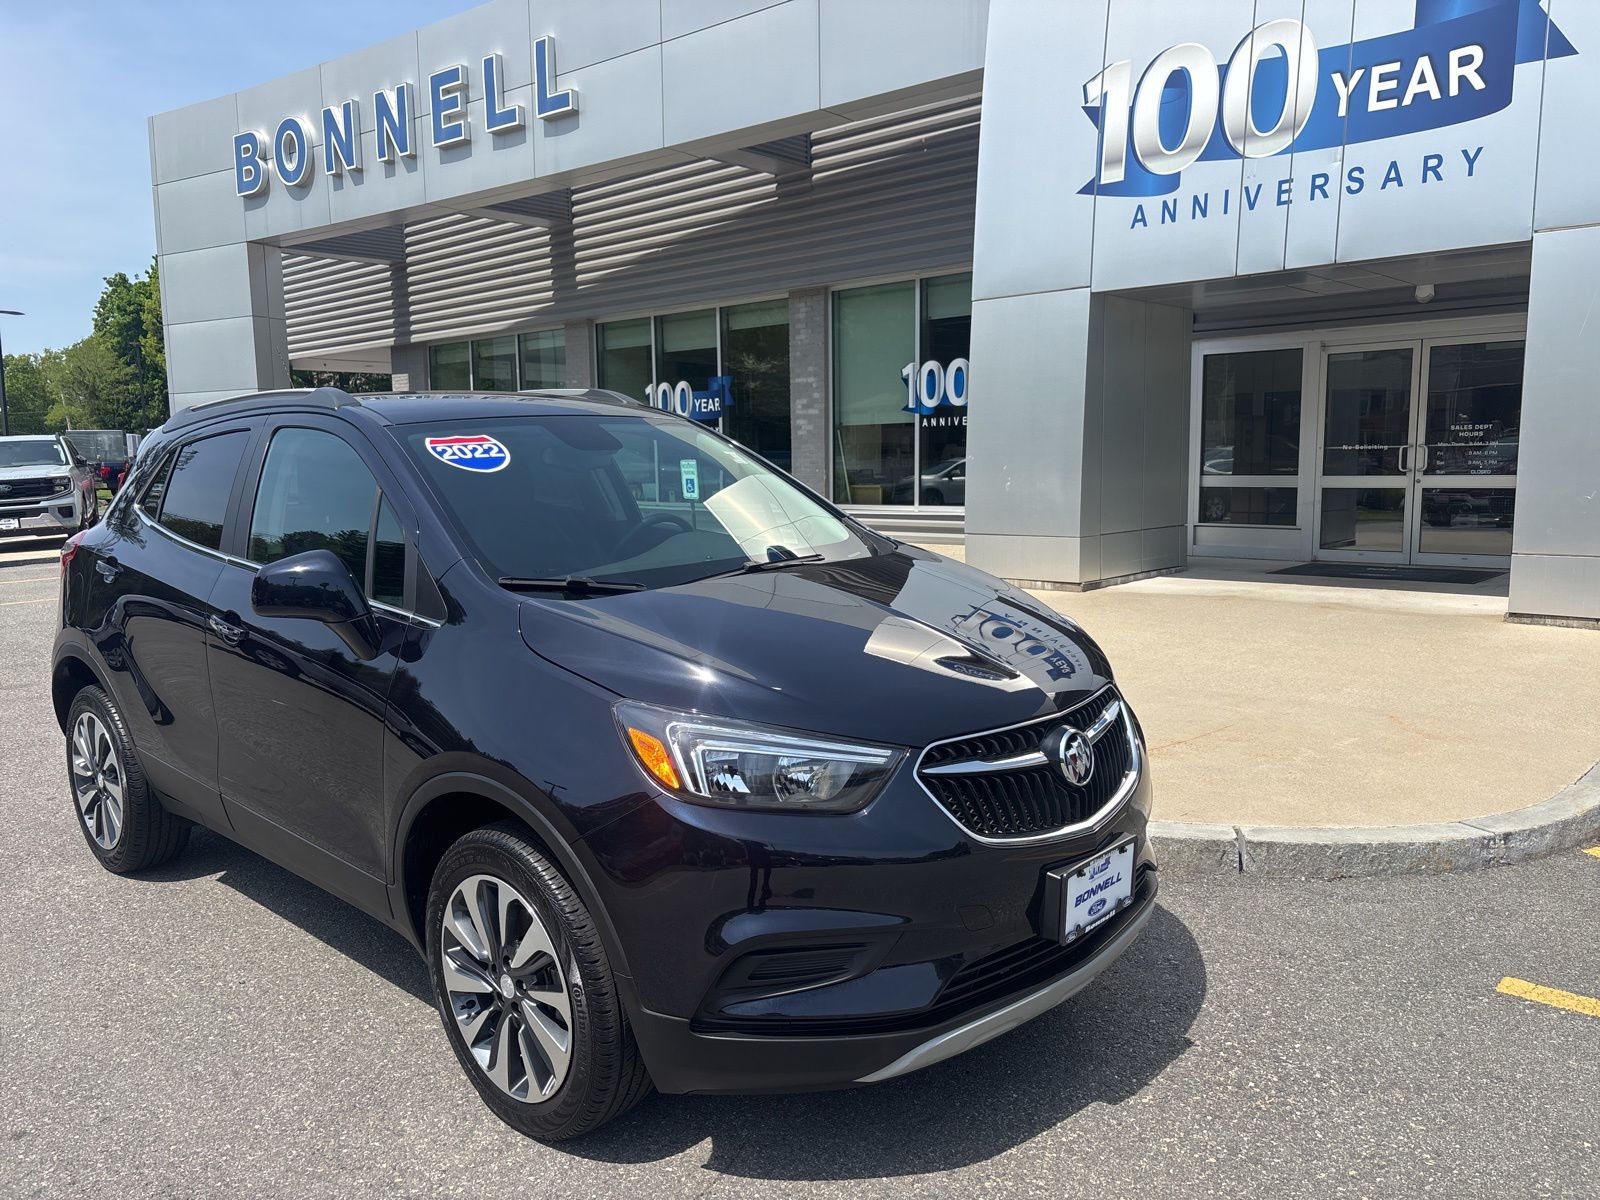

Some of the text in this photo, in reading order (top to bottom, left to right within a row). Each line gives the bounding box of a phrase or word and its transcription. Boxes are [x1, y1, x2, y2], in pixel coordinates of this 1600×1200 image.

[233, 35, 577, 197] BONNELL
[1083, 18, 1486, 185] 100 YEAR
[1130, 146, 1484, 229] ANNIVERSARY
[645, 381, 721, 418] 100 YEAR
[901, 358, 969, 408] 100
[435, 443, 506, 460] 2022
[1075, 871, 1122, 908] BONNELL
